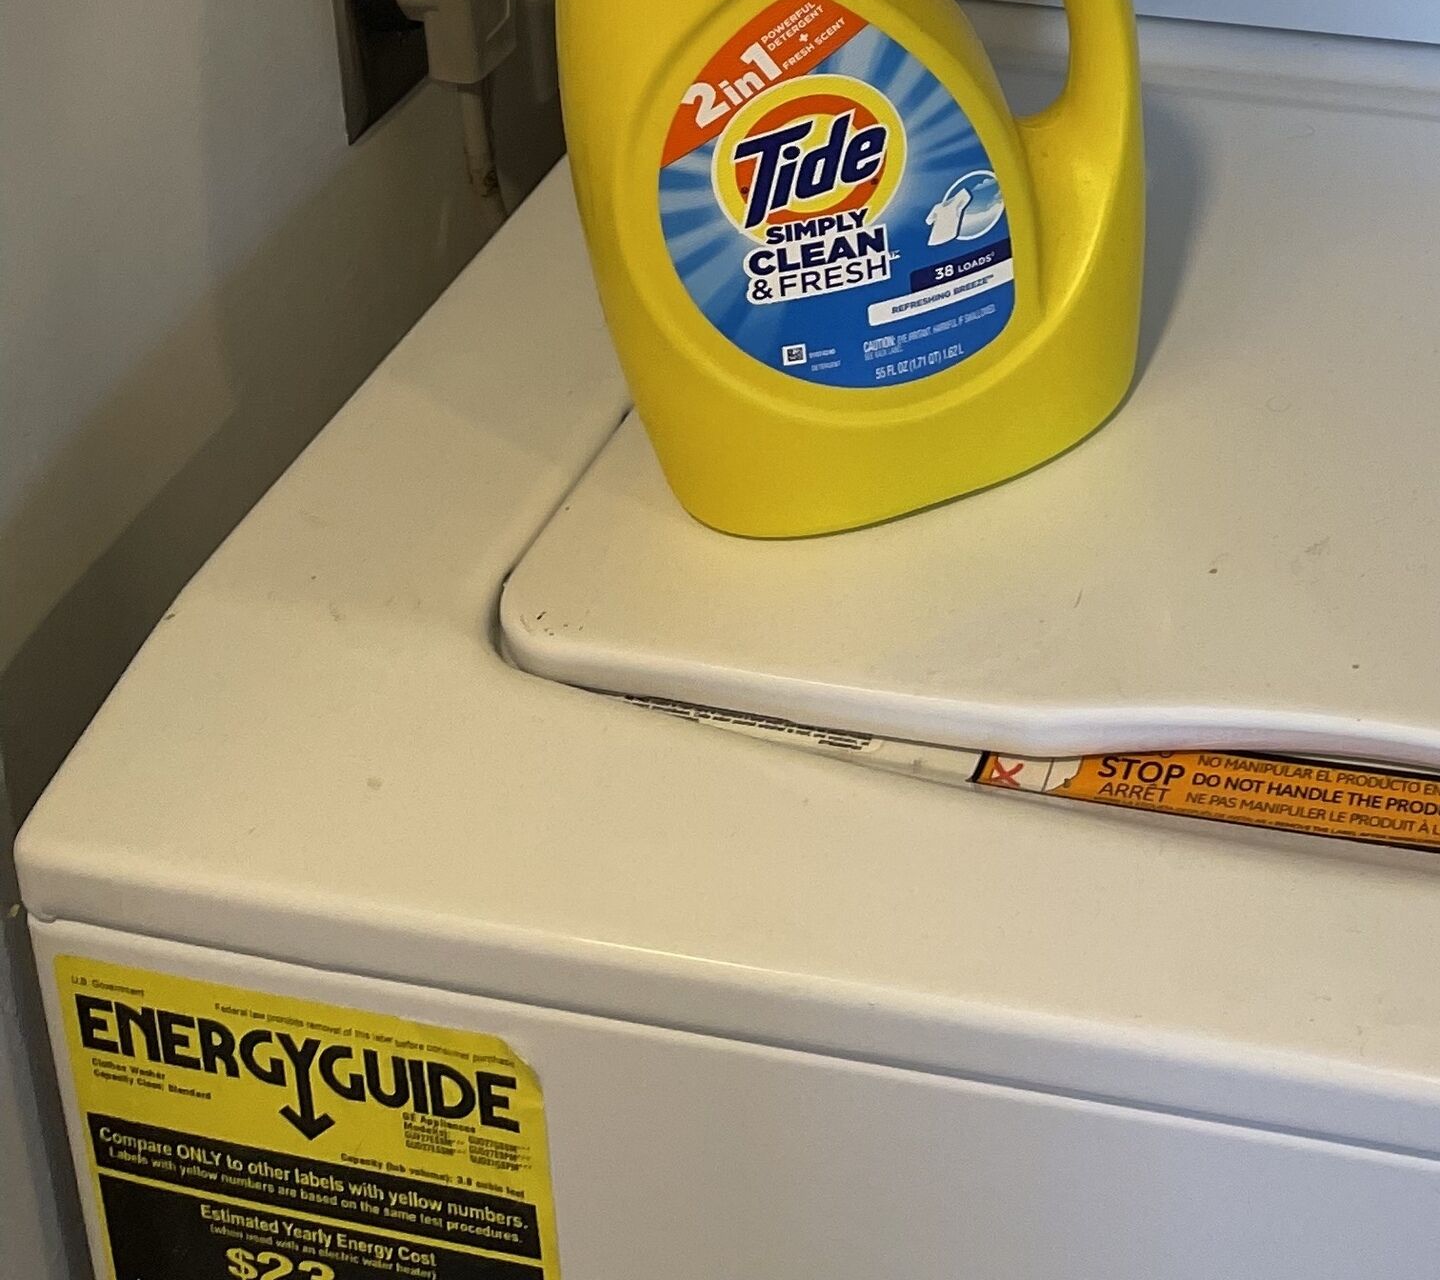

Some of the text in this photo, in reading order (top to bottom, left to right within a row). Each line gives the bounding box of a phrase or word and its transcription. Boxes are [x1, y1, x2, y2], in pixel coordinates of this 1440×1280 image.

[760, 2, 816, 44] POWERFUL
[767, 4, 824, 51] DETERGENT
[782, 17, 846, 71] FRESH SCENT
[734, 113, 887, 229] Tide
[766, 208, 868, 244] SIMPLY
[748, 227, 885, 276] CLEAN
[935, 264, 954, 280] 38
[752, 255, 888, 301] & FRESH
[891, 290, 951, 314] REFRESHING
[875, 367, 886, 380] 55
[887, 365, 897, 377] FL
[897, 361, 909, 374] OZ
[1098, 756, 1186, 787] STOP
[1192, 773, 1221, 787] DO
[1224, 777, 1265, 794] NOT
[1267, 782, 1344, 804] HANDLE
[1347, 792, 1383, 809] THE
[1197, 755, 1222, 768] NO
[1223, 757, 1312, 780] MANIPULAR
[1316, 769, 1333, 783] EL
[1336, 772, 1421, 793] PRODUCTO
[100, 1127, 529, 1230] Compare ONLY to other labels with yellow numbers.
[200, 1204, 279, 1234] Estimated
[282, 1221, 332, 1248] Yearly
[337, 1233, 393, 1260] Energy
[398, 1246, 437, 1267] Cost
